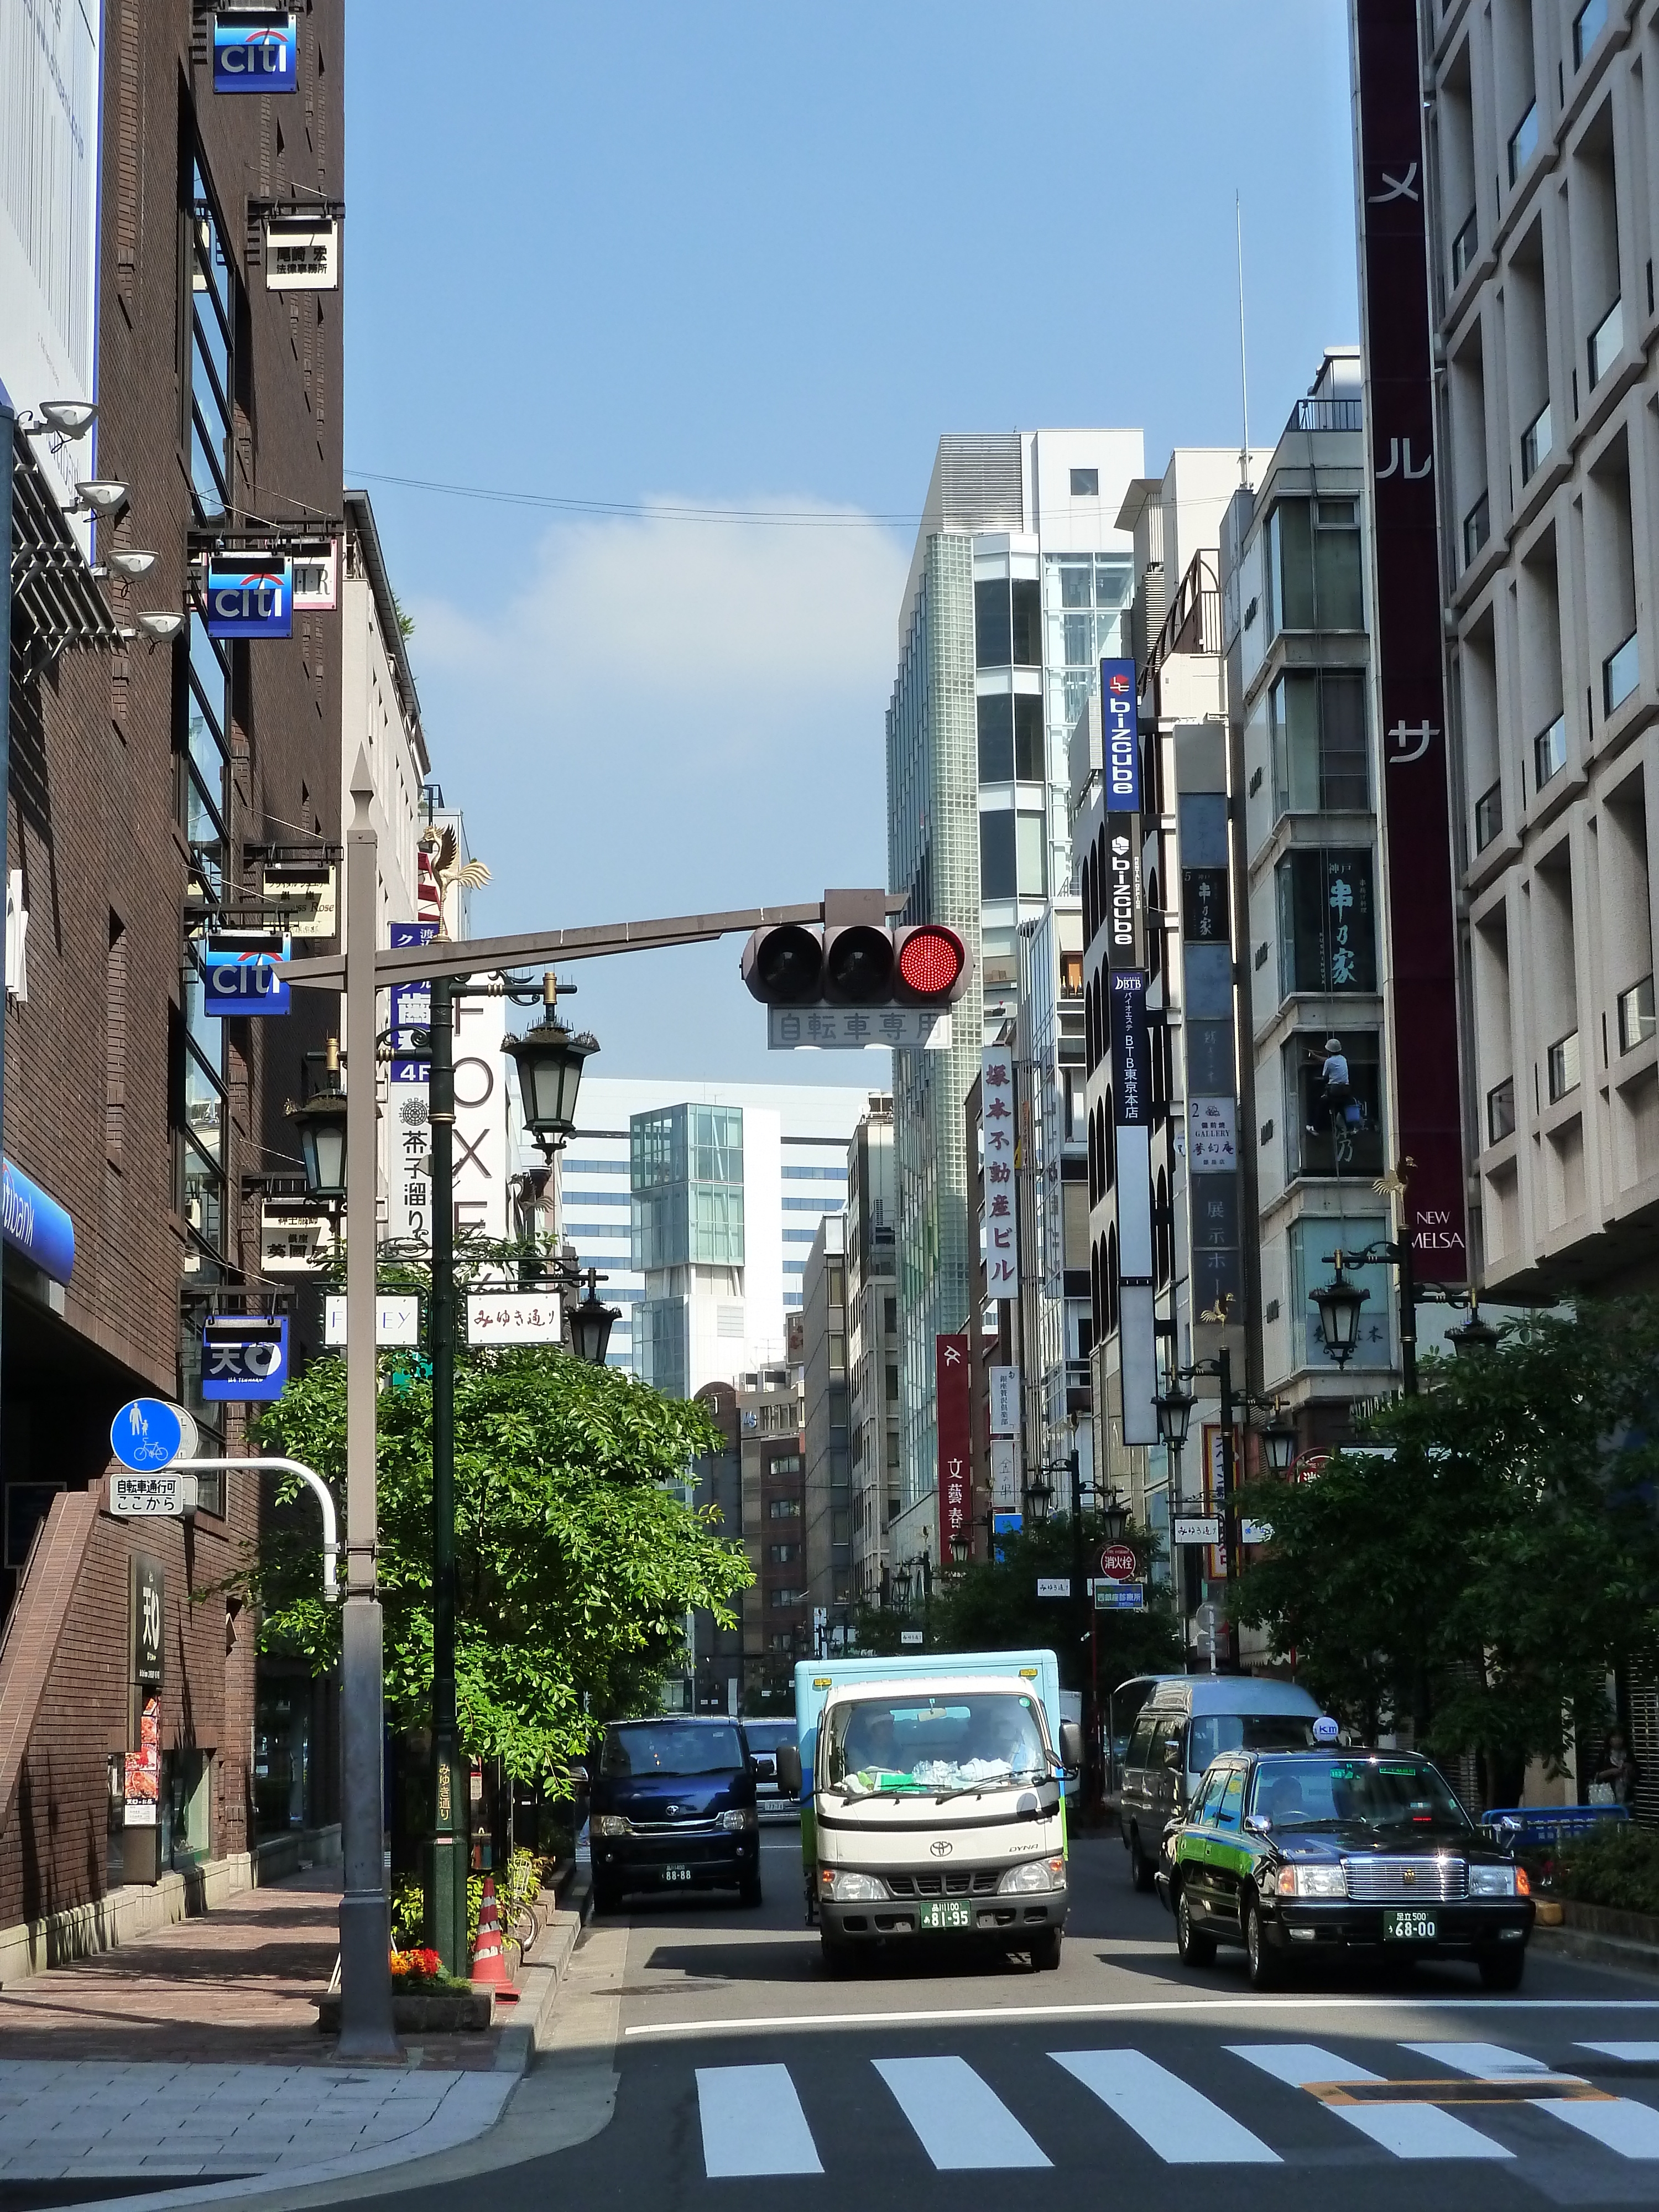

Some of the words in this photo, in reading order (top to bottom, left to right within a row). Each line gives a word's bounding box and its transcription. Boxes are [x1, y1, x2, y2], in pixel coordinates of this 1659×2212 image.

[221, 38, 286, 72] citi
[276, 263, 327, 274] 法律事務所
[215, 580, 281, 617] citi
[1110, 698, 1133, 795] bizcube
[1185, 872, 1191, 881] 5
[311, 902, 334, 912] Rose
[1112, 857, 1133, 945] bizcube
[212, 956, 280, 994] citi
[1124, 992, 1133, 1032] バイオエステ
[780, 1012, 941, 1041] 自転車専用
[1192, 1103, 1199, 1118] 2
[1417, 1211, 1451, 1224] NEW
[332, 1311, 410, 1329] FEY
[474, 1309, 554, 1327] みゆき通り
[117, 1479, 176, 1494] 自転車通行可
[118, 1496, 175, 1511] ここから
[1105, 1556, 1132, 1569] 消火栓
[439, 1764, 451, 1820] みゆき通り
[1009, 1844, 1038, 1852] DYNA
[666, 1870, 691, 1880] 88-88
[924, 1916, 930, 1924] あ
[932, 1911, 968, 1926] 81-95
[1388, 1924, 1393, 1933] う
[1395, 1922, 1435, 1937] 68-00
